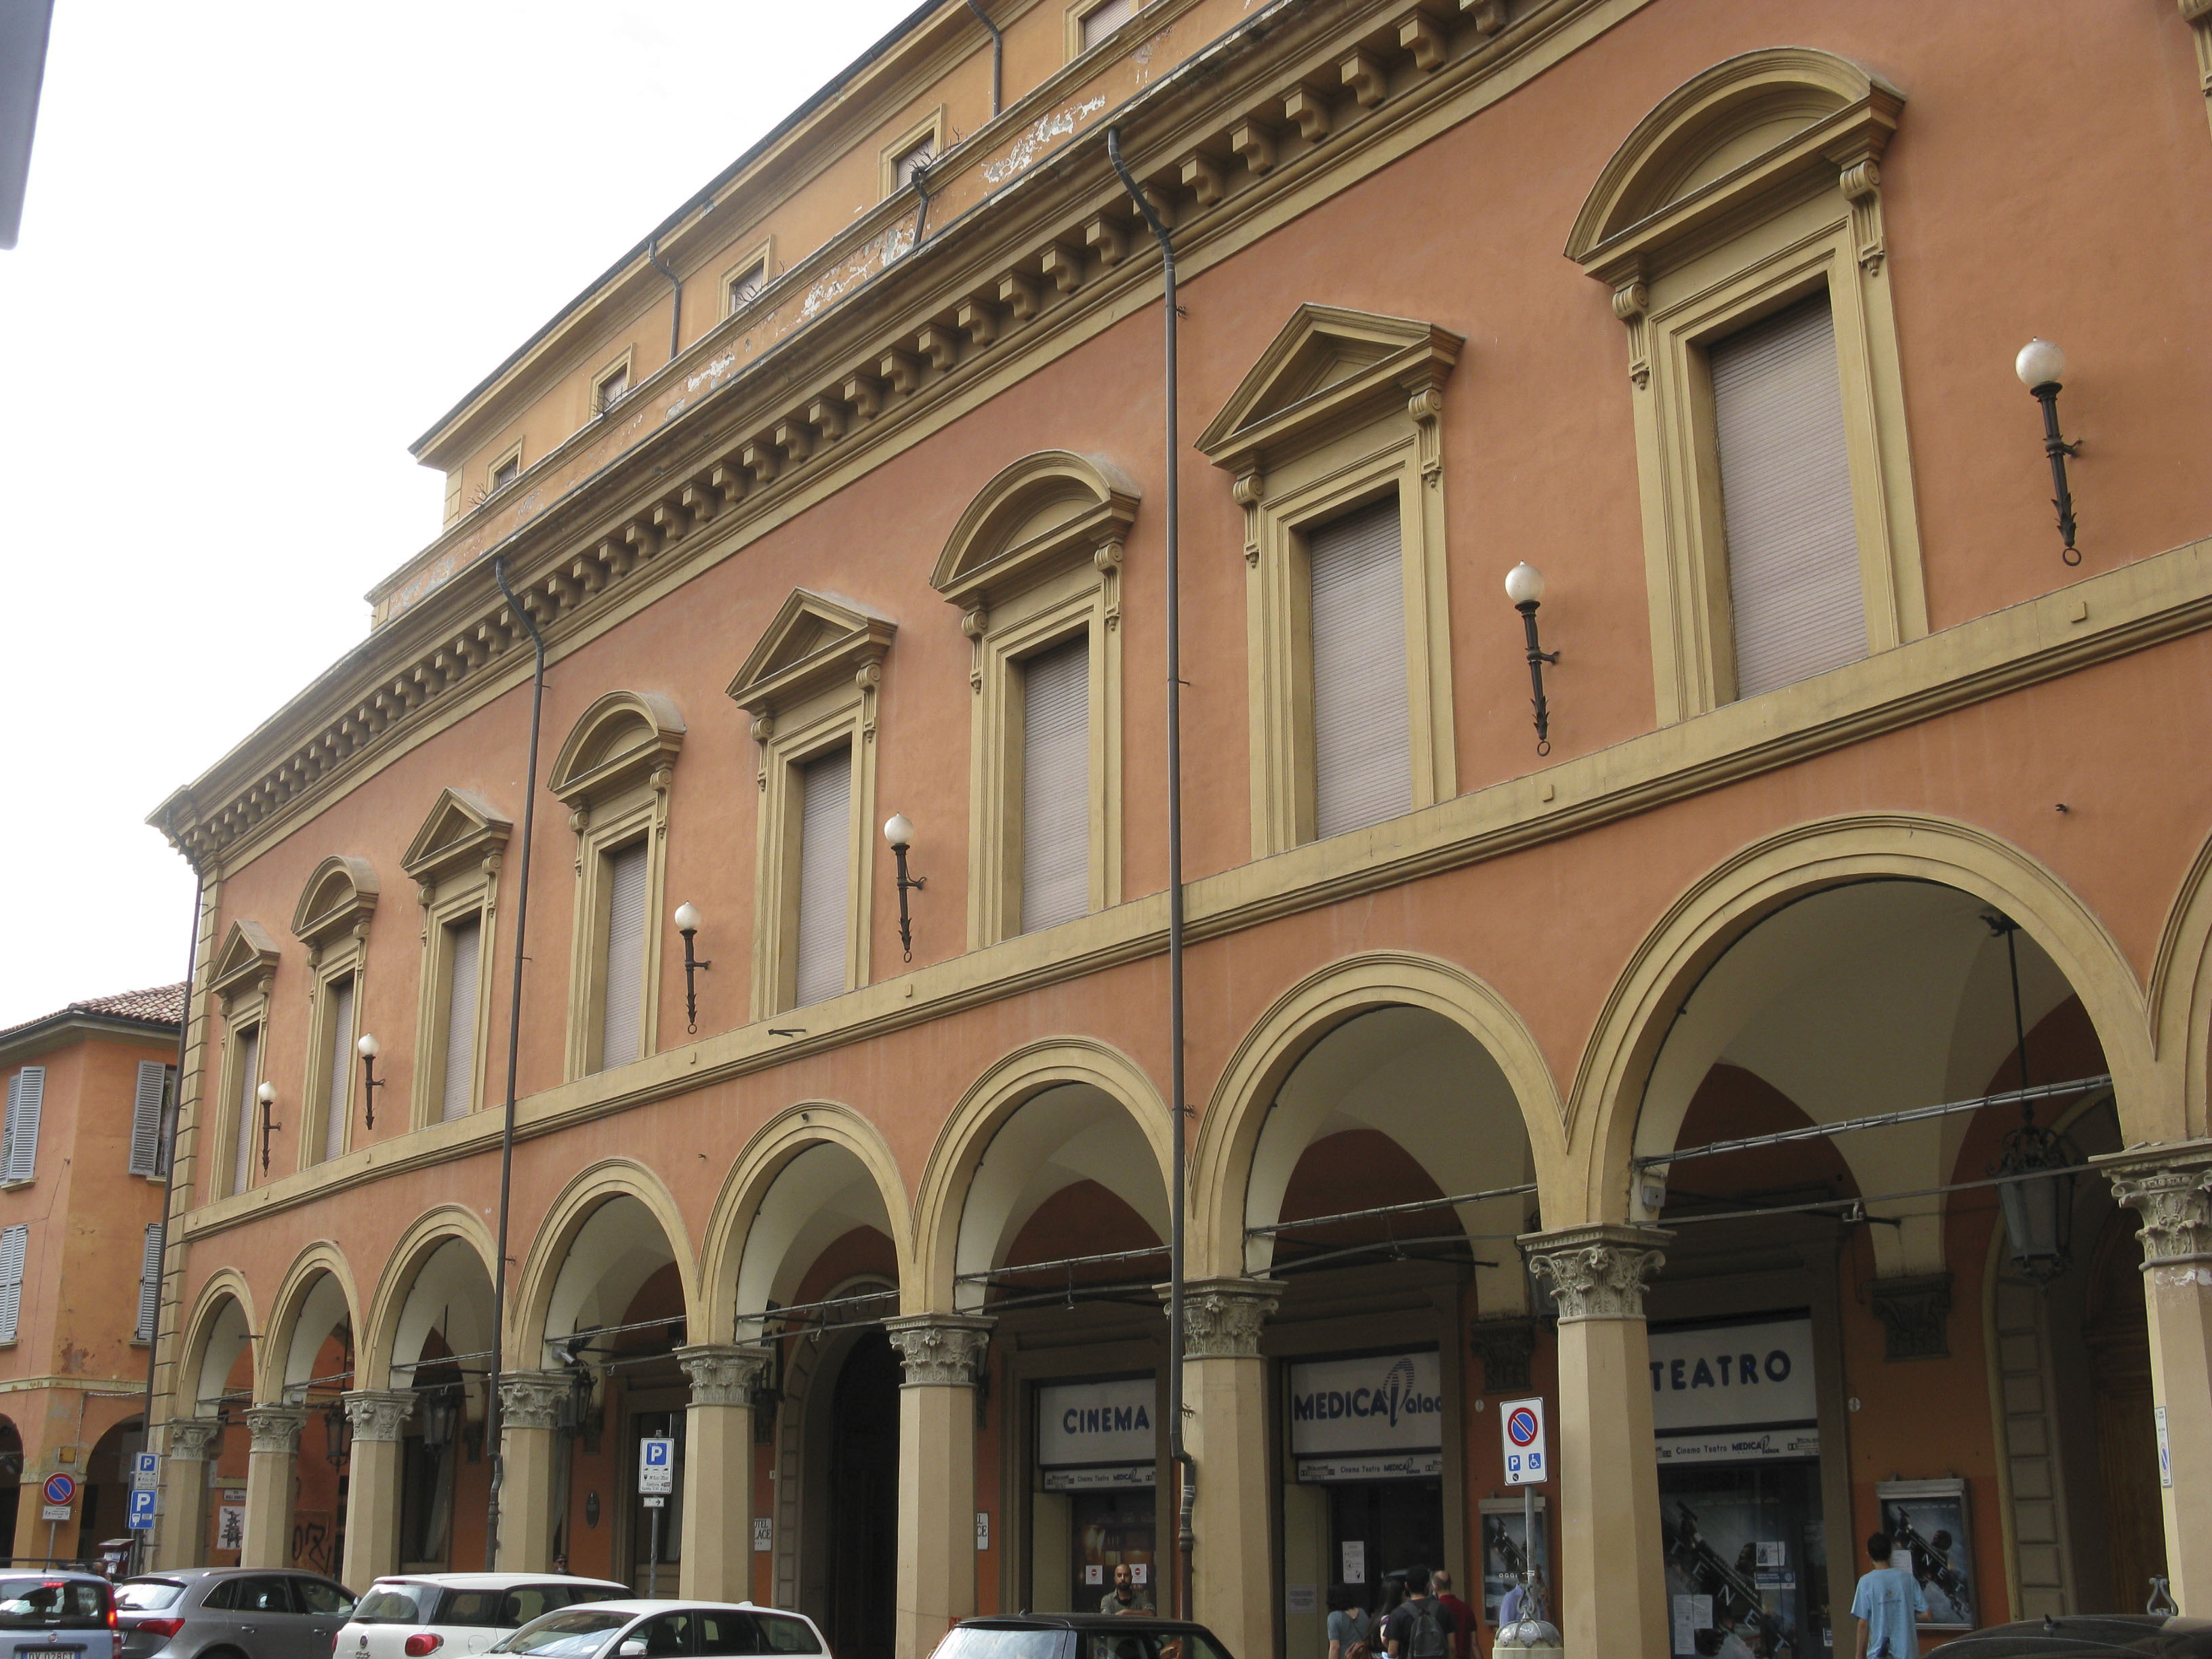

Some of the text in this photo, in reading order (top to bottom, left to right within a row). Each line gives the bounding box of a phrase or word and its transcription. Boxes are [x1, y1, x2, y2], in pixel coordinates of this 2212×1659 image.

[1650, 1350, 1791, 1391] TEATRO
[1063, 1405, 1150, 1435] CINEMA
[1294, 1388, 1389, 1421] MEDICA
